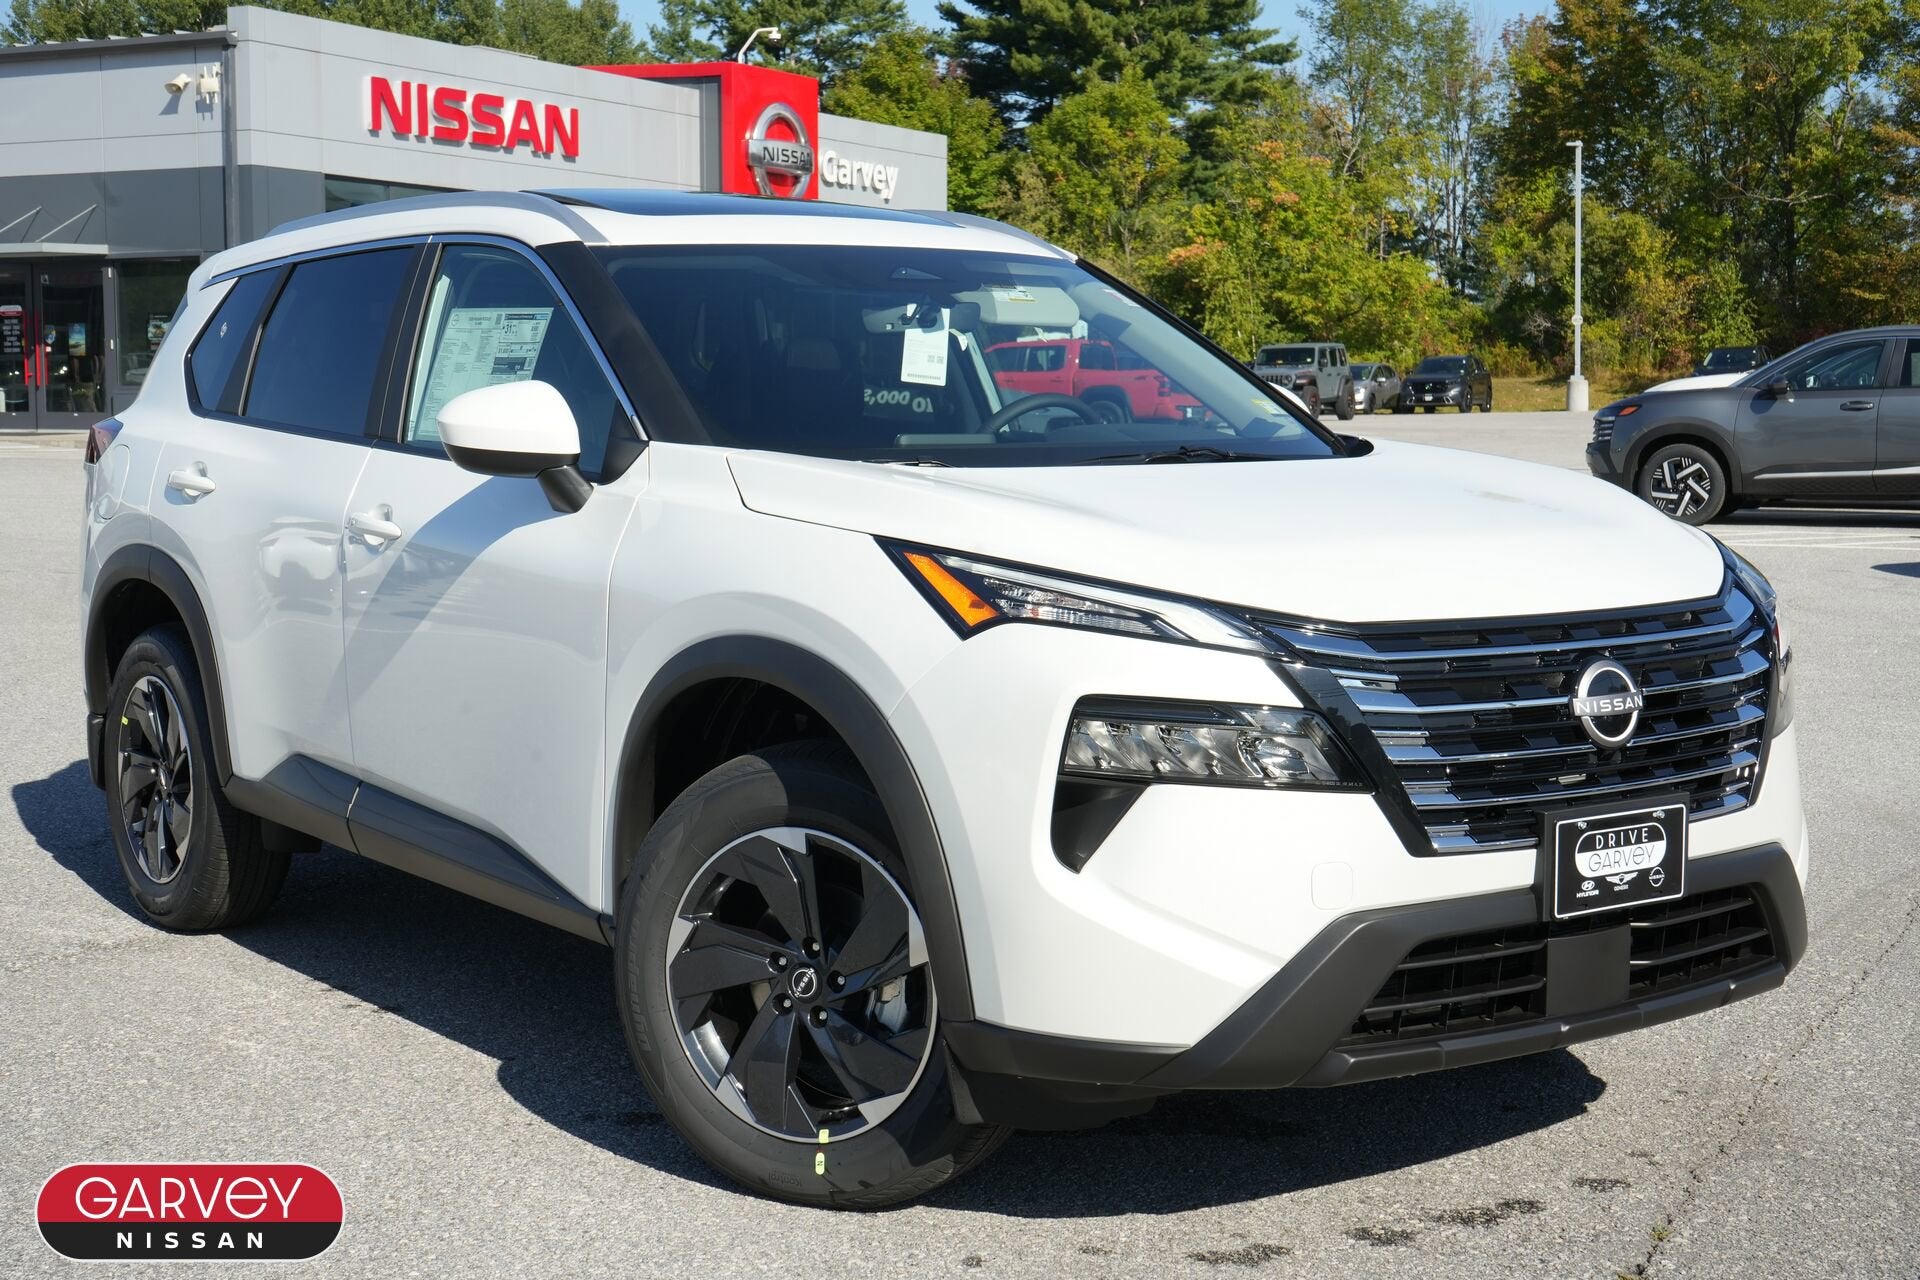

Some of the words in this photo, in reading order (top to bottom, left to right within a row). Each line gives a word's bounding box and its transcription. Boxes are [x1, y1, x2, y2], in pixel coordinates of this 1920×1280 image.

[370, 76, 579, 156] NISSAN
[762, 146, 812, 166] NISSAN
[822, 150, 898, 199] Garvey
[1575, 694, 1643, 715] NISSAN
[1595, 827, 1649, 850] DRIVE
